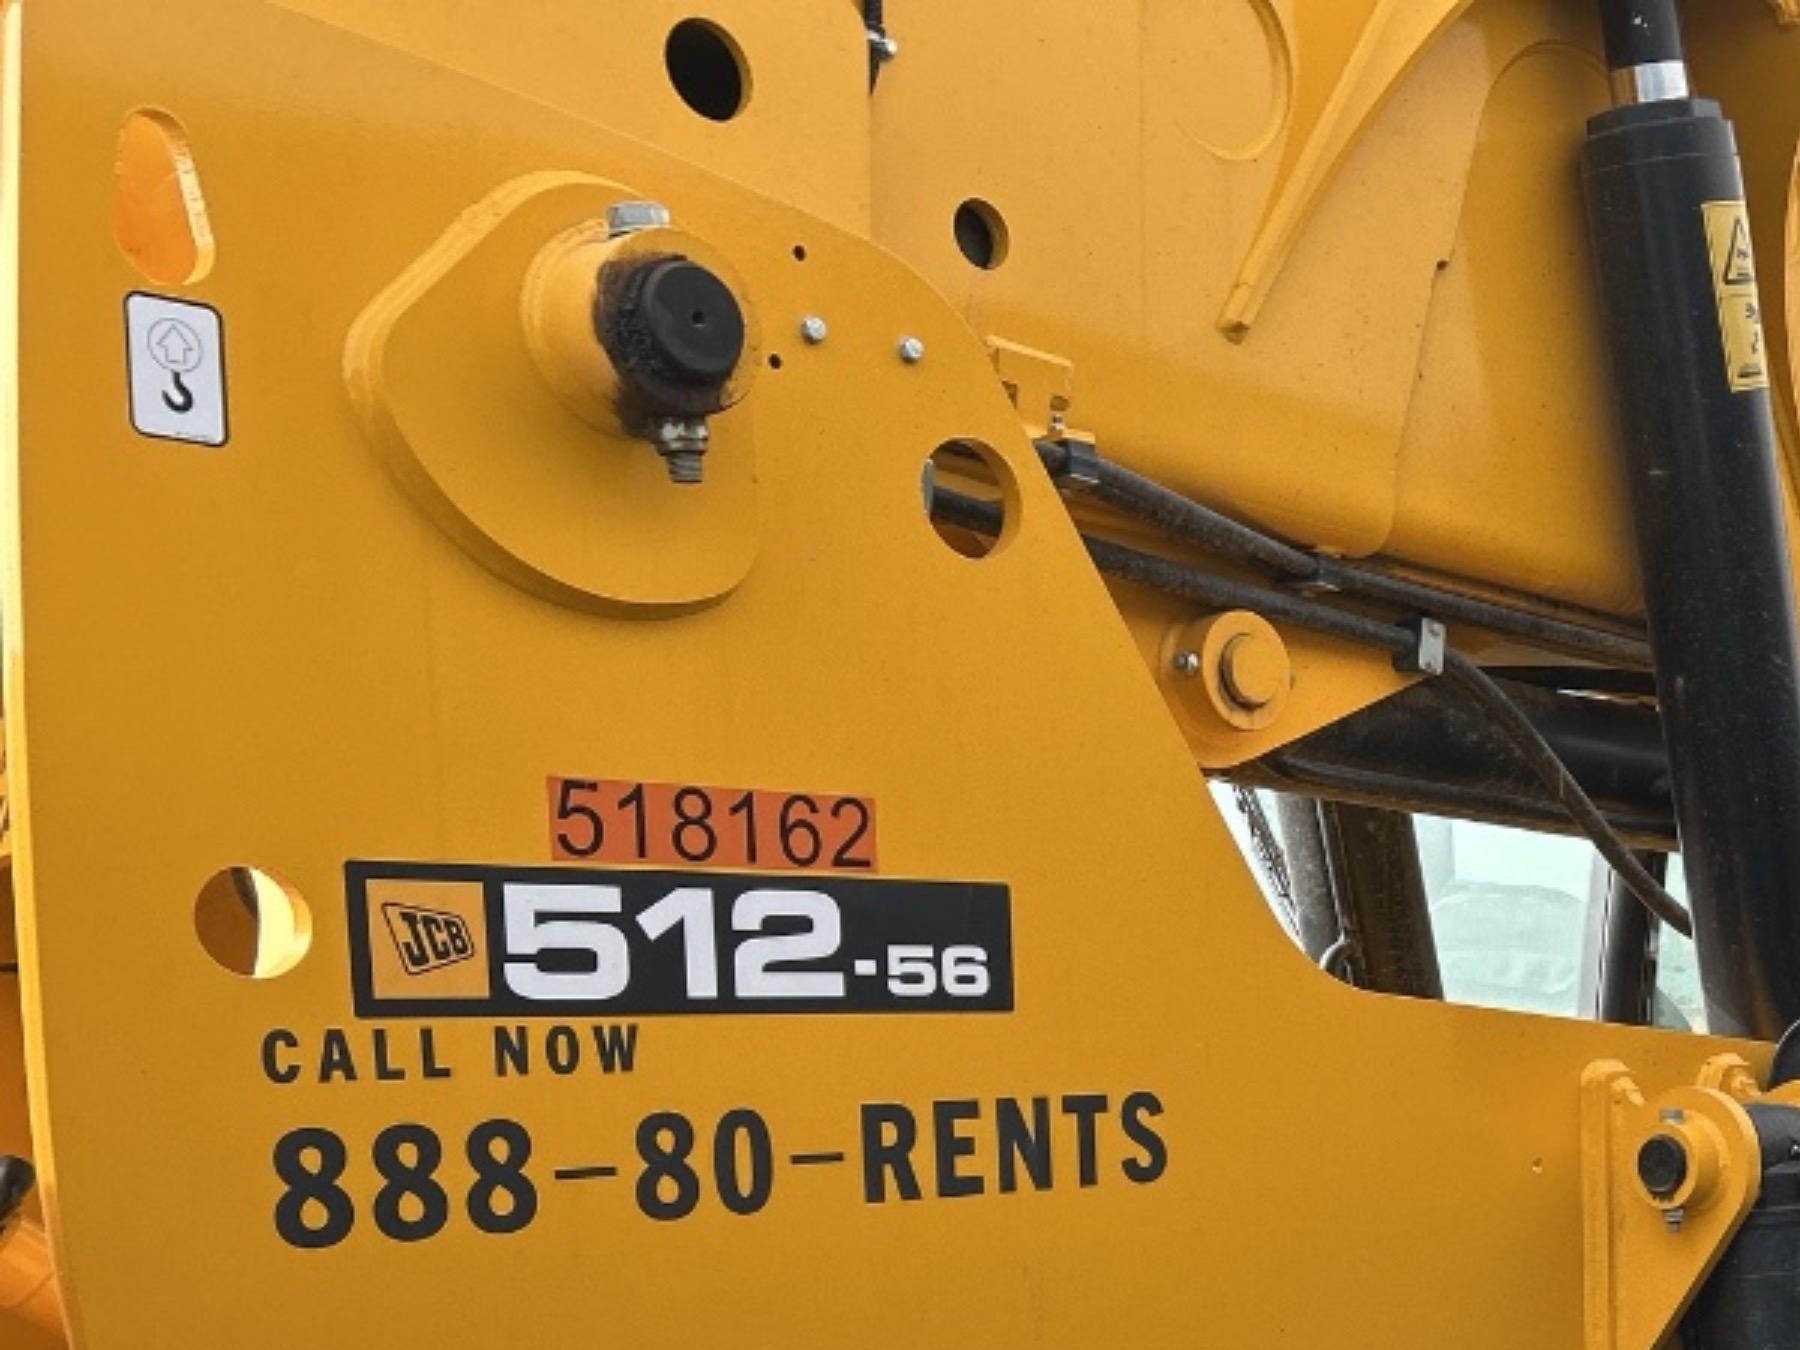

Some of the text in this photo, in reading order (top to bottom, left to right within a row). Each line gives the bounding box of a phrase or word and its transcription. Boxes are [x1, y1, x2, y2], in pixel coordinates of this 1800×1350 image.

[554, 778, 875, 869] 518162
[392, 883, 991, 1000] JCB 512-56
[261, 1022, 641, 1084] CALL NOW
[272, 1089, 1169, 1250] 888-80-RENTS
